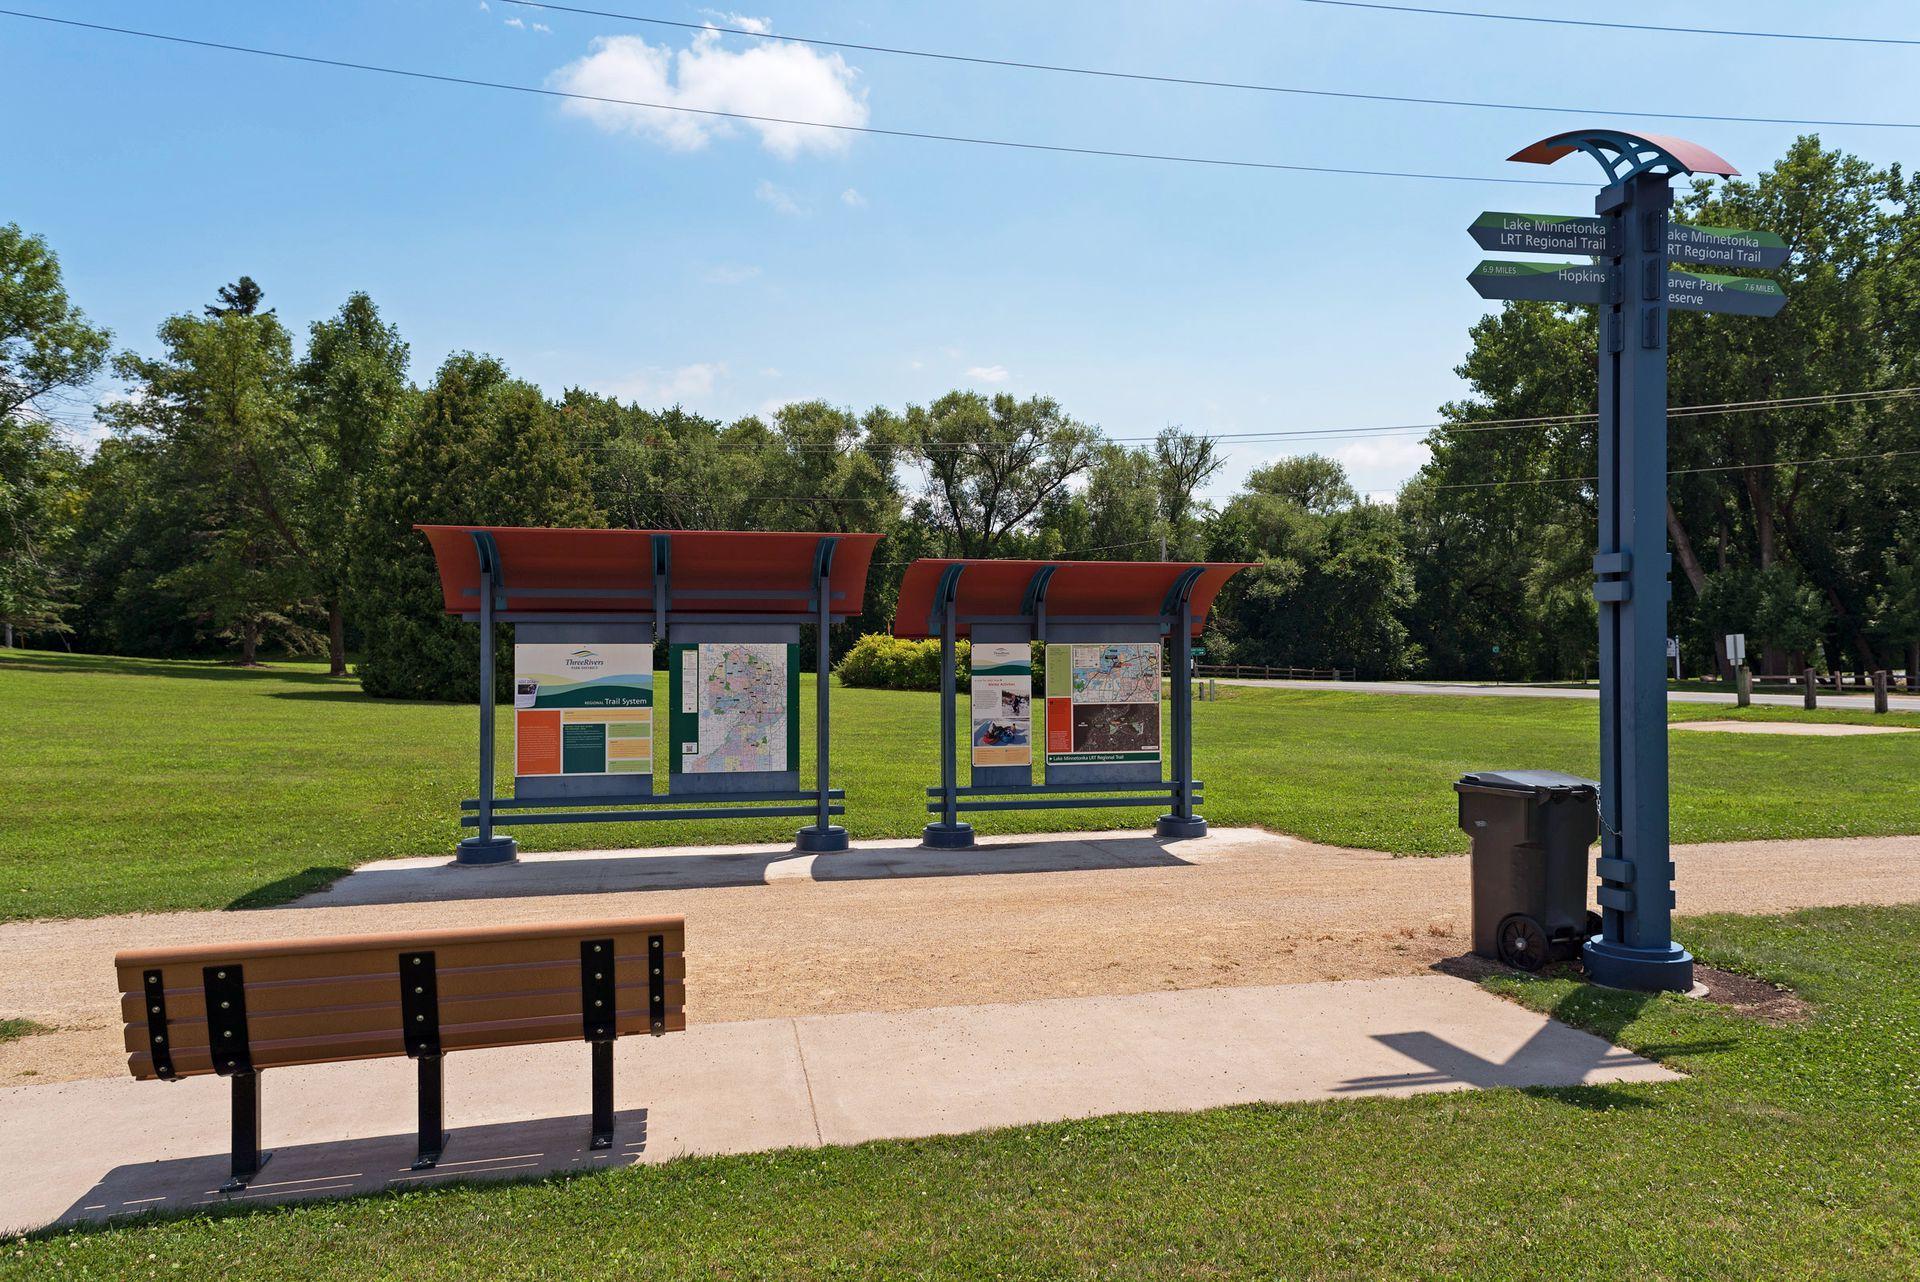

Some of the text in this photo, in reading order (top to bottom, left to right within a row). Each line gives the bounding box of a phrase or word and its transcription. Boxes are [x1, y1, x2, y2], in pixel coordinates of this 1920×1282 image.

[1503, 218, 1606, 235] Lake Minnetonka
[1501, 233, 1606, 250] LRT Regional Trail
[1667, 229, 1759, 248] ake Minnetonka
[1667, 244, 1761, 262] RT Regional Trail
[1482, 266, 1517, 275] 6.9 MILES
[1558, 269, 1606, 284] Hopkins
[1667, 278, 1724, 292] arver Park
[1744, 283, 1775, 293] 7.6 MILES
[1668, 293, 1704, 305] eserve
[622, 698, 647, 706] System
